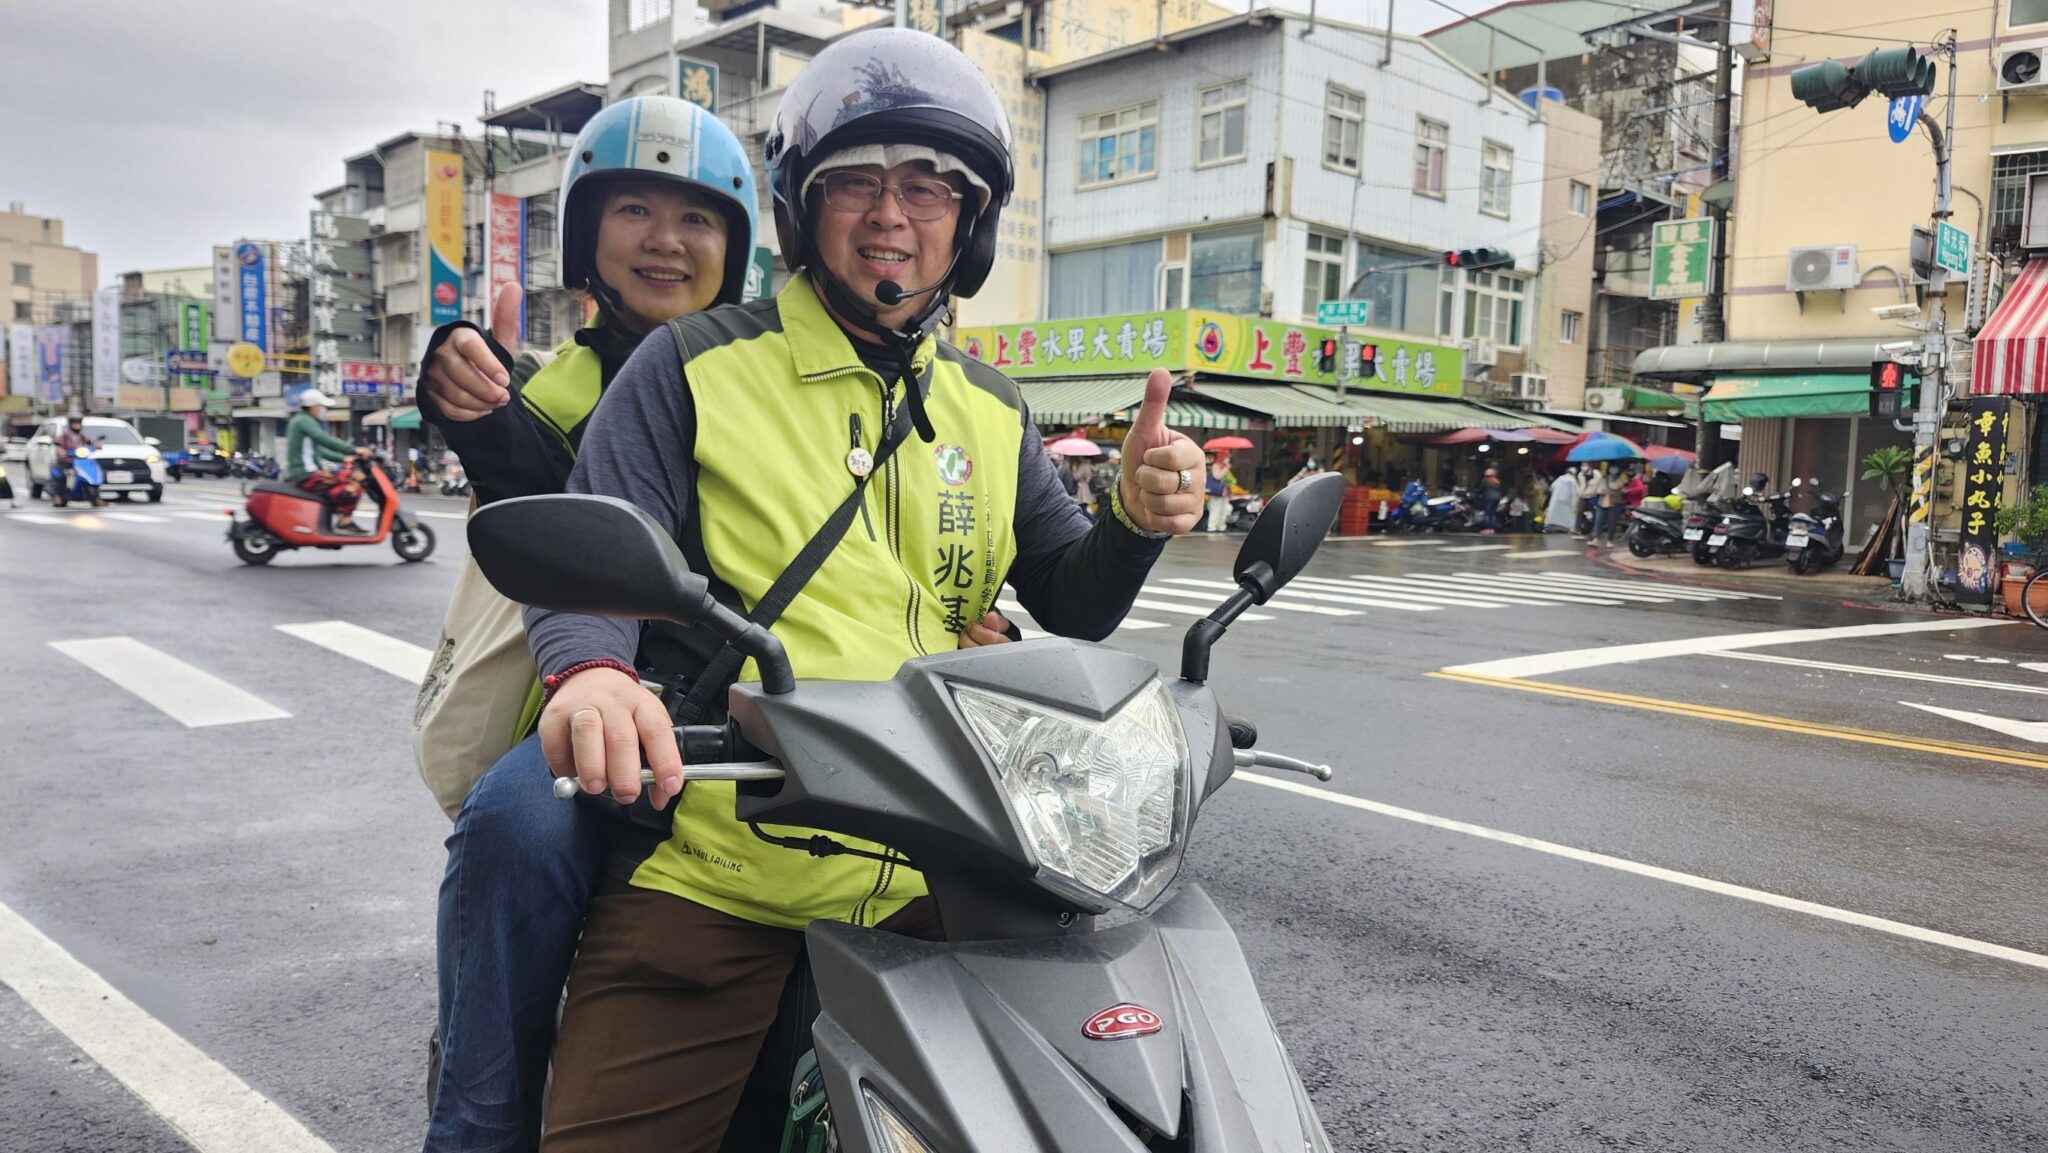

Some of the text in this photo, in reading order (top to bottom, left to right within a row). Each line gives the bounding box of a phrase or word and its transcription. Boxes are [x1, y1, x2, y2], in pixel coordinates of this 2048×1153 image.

[993, 318, 1168, 368] 上豐水果大賣場
[1967, 410, 1996, 536] 章魚小丸子
[1095, 1012, 1155, 1033] PGO
